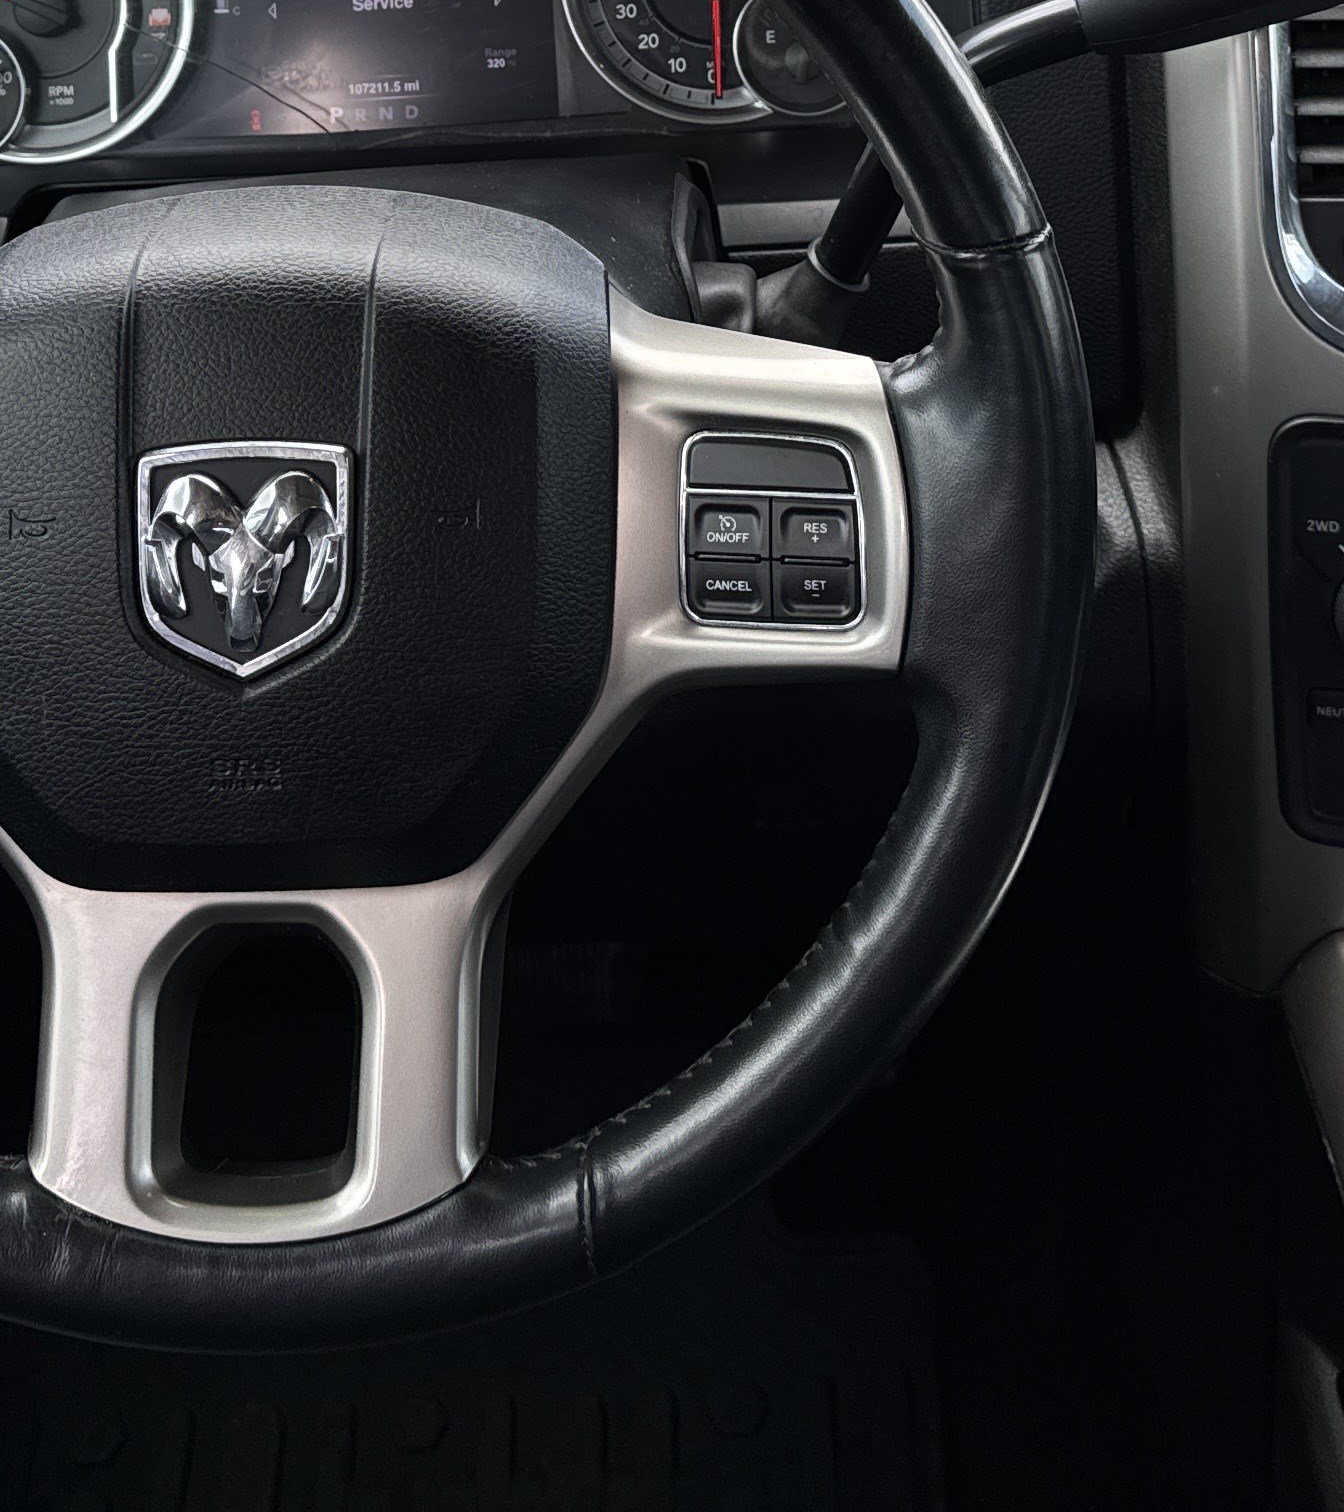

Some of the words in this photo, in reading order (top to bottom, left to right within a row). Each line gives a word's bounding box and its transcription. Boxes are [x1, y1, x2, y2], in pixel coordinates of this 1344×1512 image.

[615, 3, 638, 20] 30
[637, 33, 660, 50] 20
[765, 29, 776, 45] E
[484, 46, 518, 59] Range
[486, 57, 506, 69] 320
[667, 57, 688, 74] 10
[47, 85, 75, 97] RPM
[348, 80, 401, 95] 107211.5
[404, 79, 420, 93] mi
[329, 106, 345, 125] P
[355, 107, 368, 122] R
[378, 105, 394, 121] N
[405, 104, 420, 120] D
[803, 522, 828, 534] RES
[1306, 519, 1341, 533] 2WD
[706, 531, 750, 544] ON/OFF
[706, 579, 753, 592] CANCEL
[803, 579, 827, 591] SET
